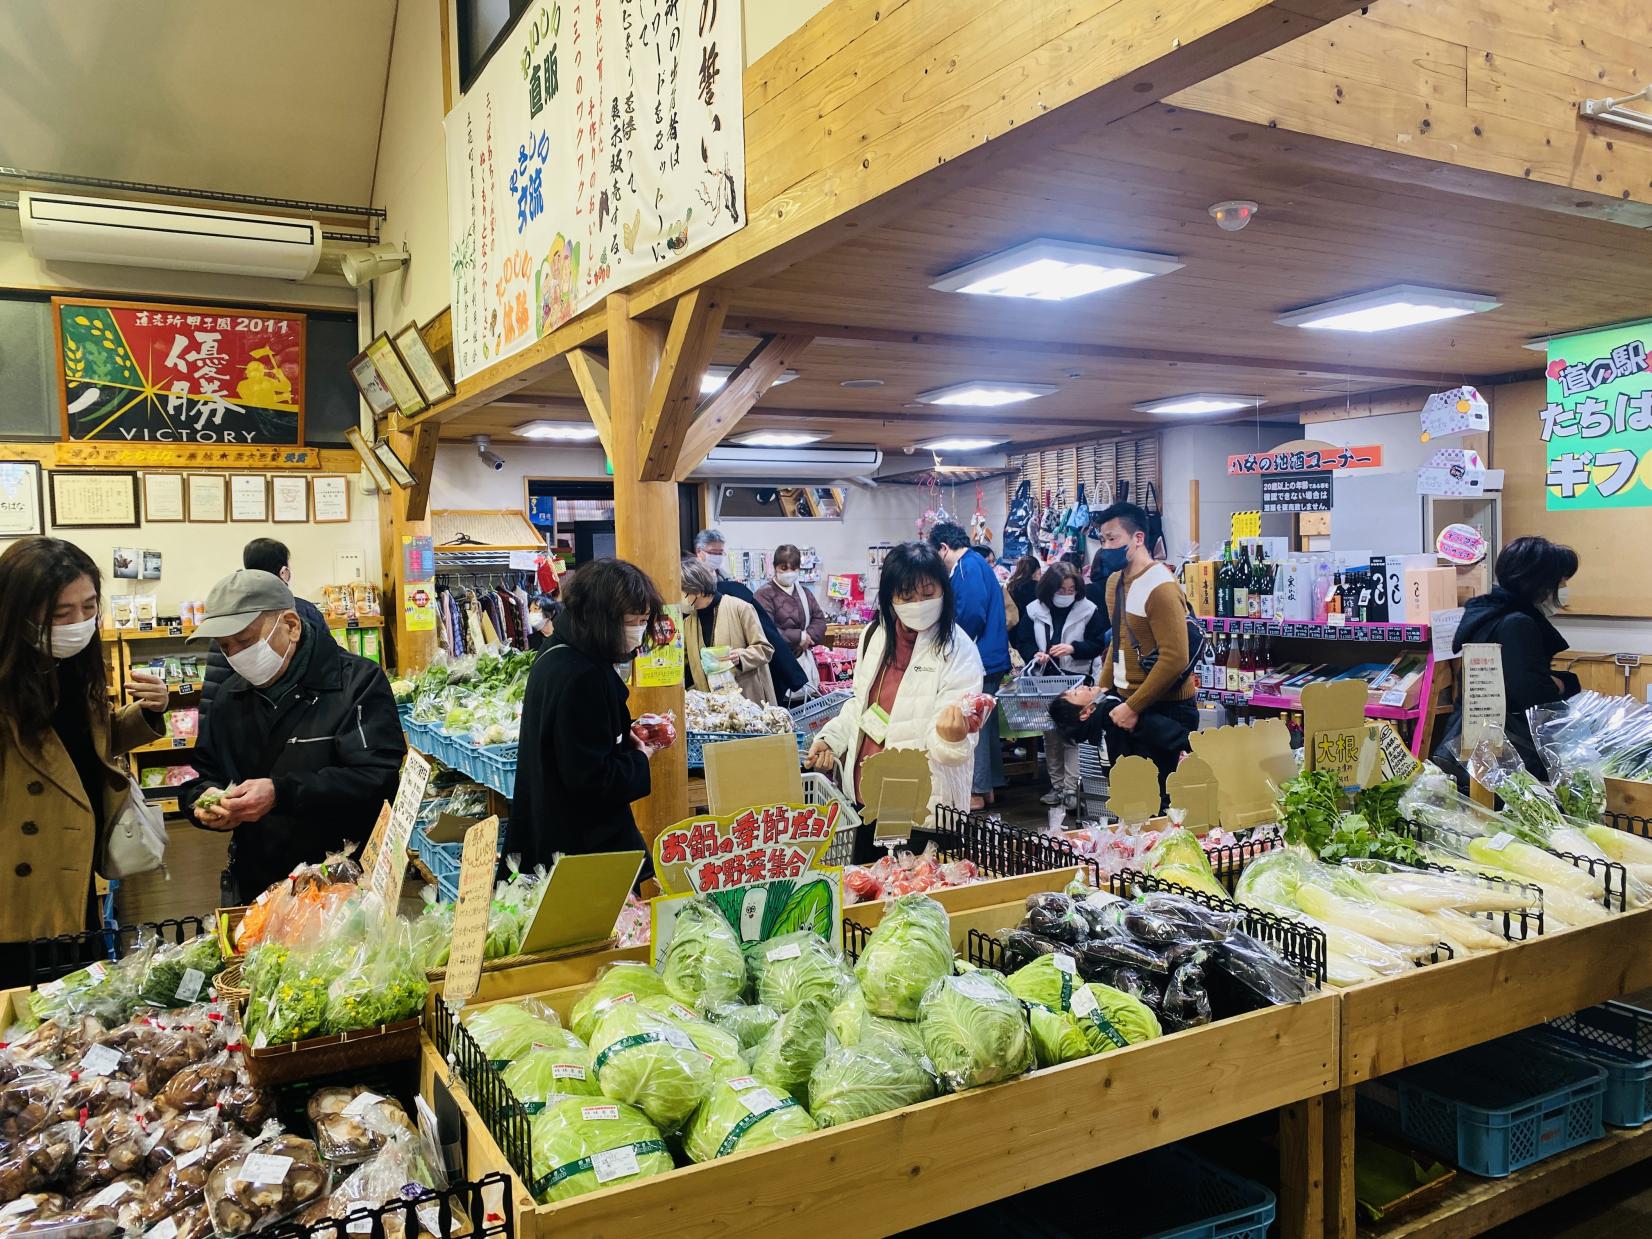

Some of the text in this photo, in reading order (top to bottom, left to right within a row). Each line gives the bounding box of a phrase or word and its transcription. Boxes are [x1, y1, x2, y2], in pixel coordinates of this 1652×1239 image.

[1558, 339, 1650, 398] 道の駅
[119, 427, 257, 444] VICTORY
[1231, 447, 1372, 473] 八女の地酒コーナー
[1316, 733, 1359, 764] 大根
[697, 846, 808, 893] お野菜集合
